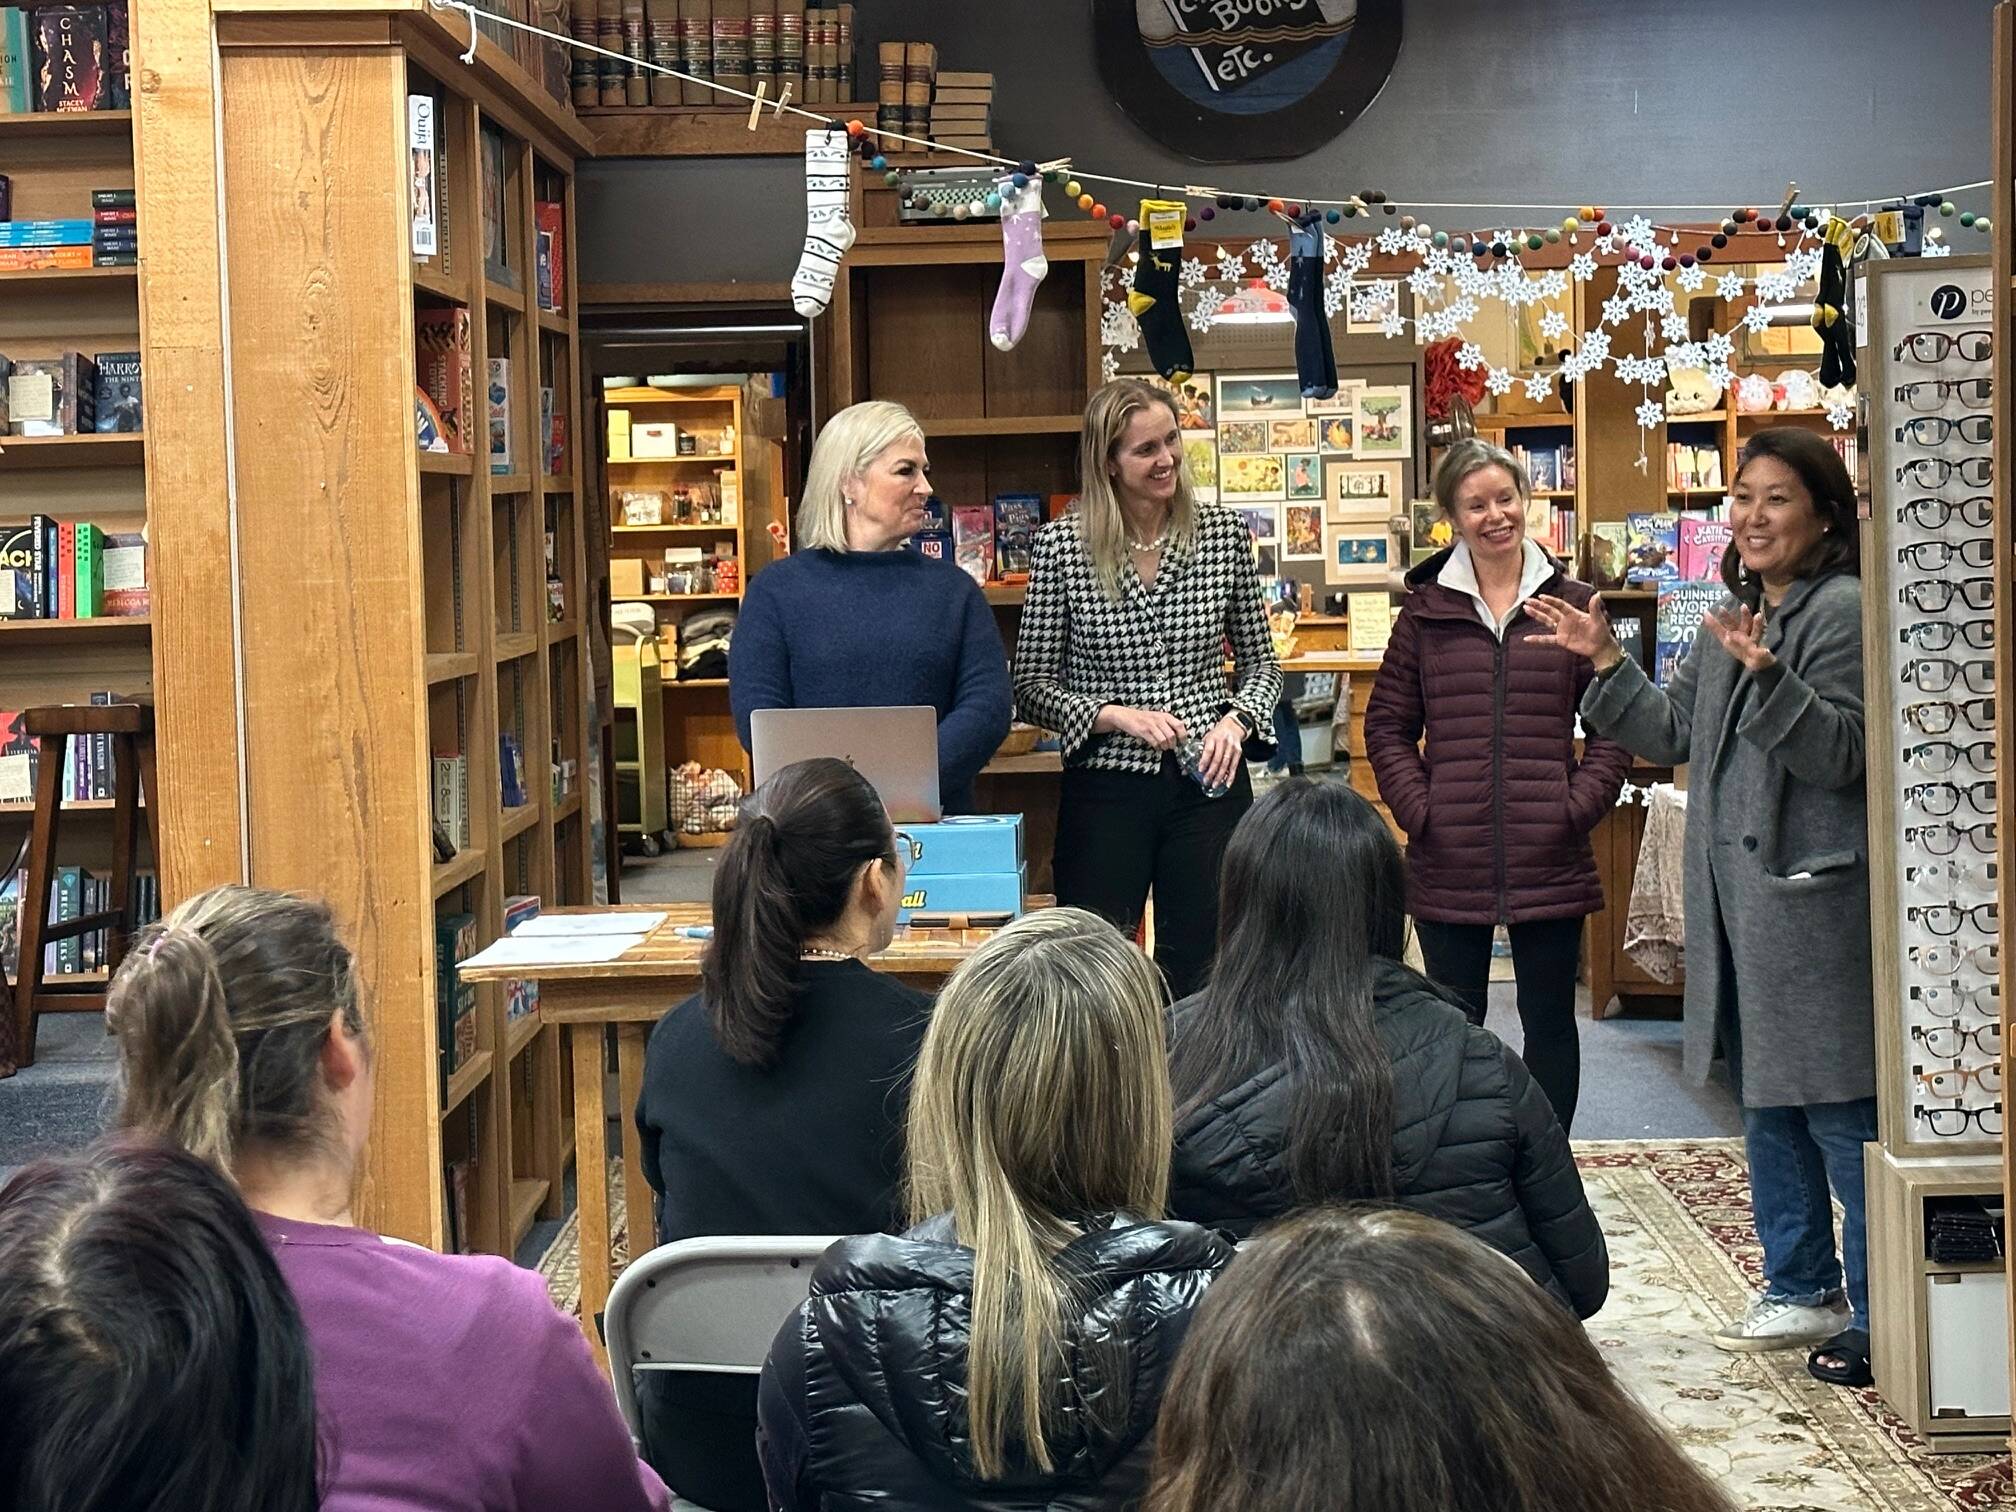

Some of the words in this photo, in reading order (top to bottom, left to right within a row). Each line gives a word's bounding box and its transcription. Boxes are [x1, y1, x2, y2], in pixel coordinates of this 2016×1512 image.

[60, 17, 80, 96] CHASM
[1971, 289, 1993, 308] pe
[99, 362, 142, 376] HARRO
[438, 354, 448, 407] STACKING
[1696, 526, 1723, 536] KATIE
[924, 543, 940, 553] NO
[1671, 590, 1730, 601] GUINNESS
[1671, 601, 1714, 614] WOR
[1670, 614, 1704, 625] RECO
[1670, 626, 1697, 643] 20
[901, 891, 926, 908] all
[60, 938, 68, 961] EEKS
